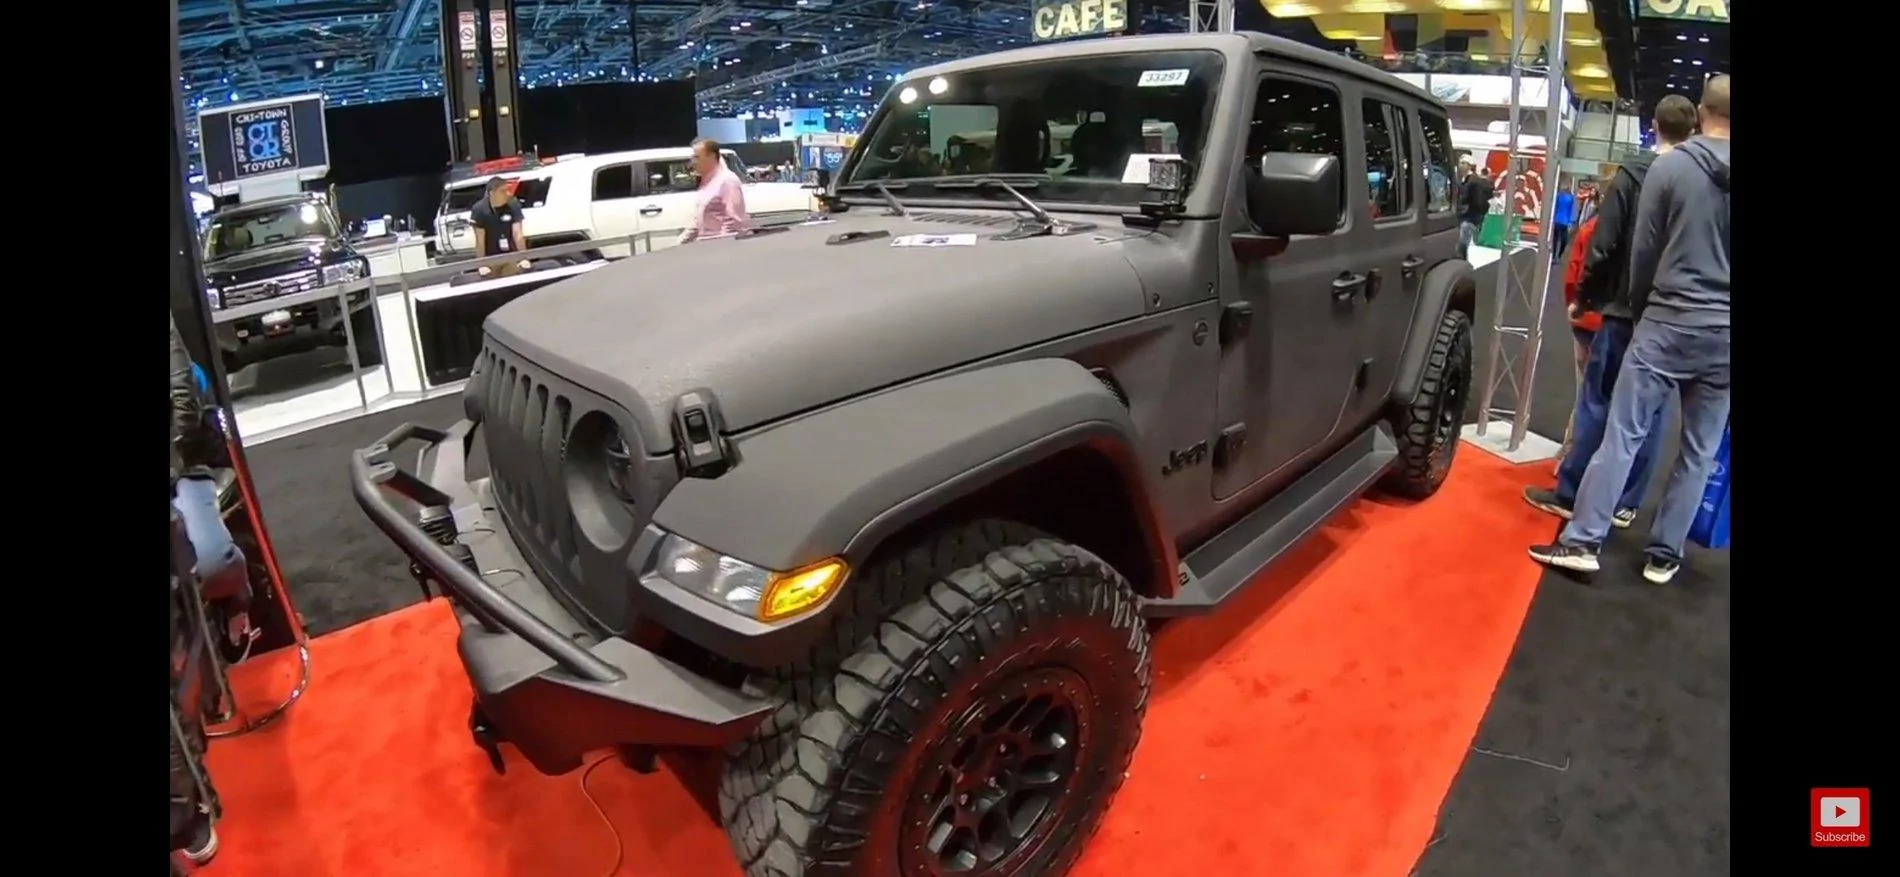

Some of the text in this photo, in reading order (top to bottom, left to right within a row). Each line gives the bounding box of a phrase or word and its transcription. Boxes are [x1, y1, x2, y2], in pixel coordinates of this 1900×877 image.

[1035, 0, 1124, 38] CAFE
[236, 109, 287, 124] CHI-TOWN
[242, 158, 291, 173] TOYOTA
[1162, 439, 1208, 476] Jeep
